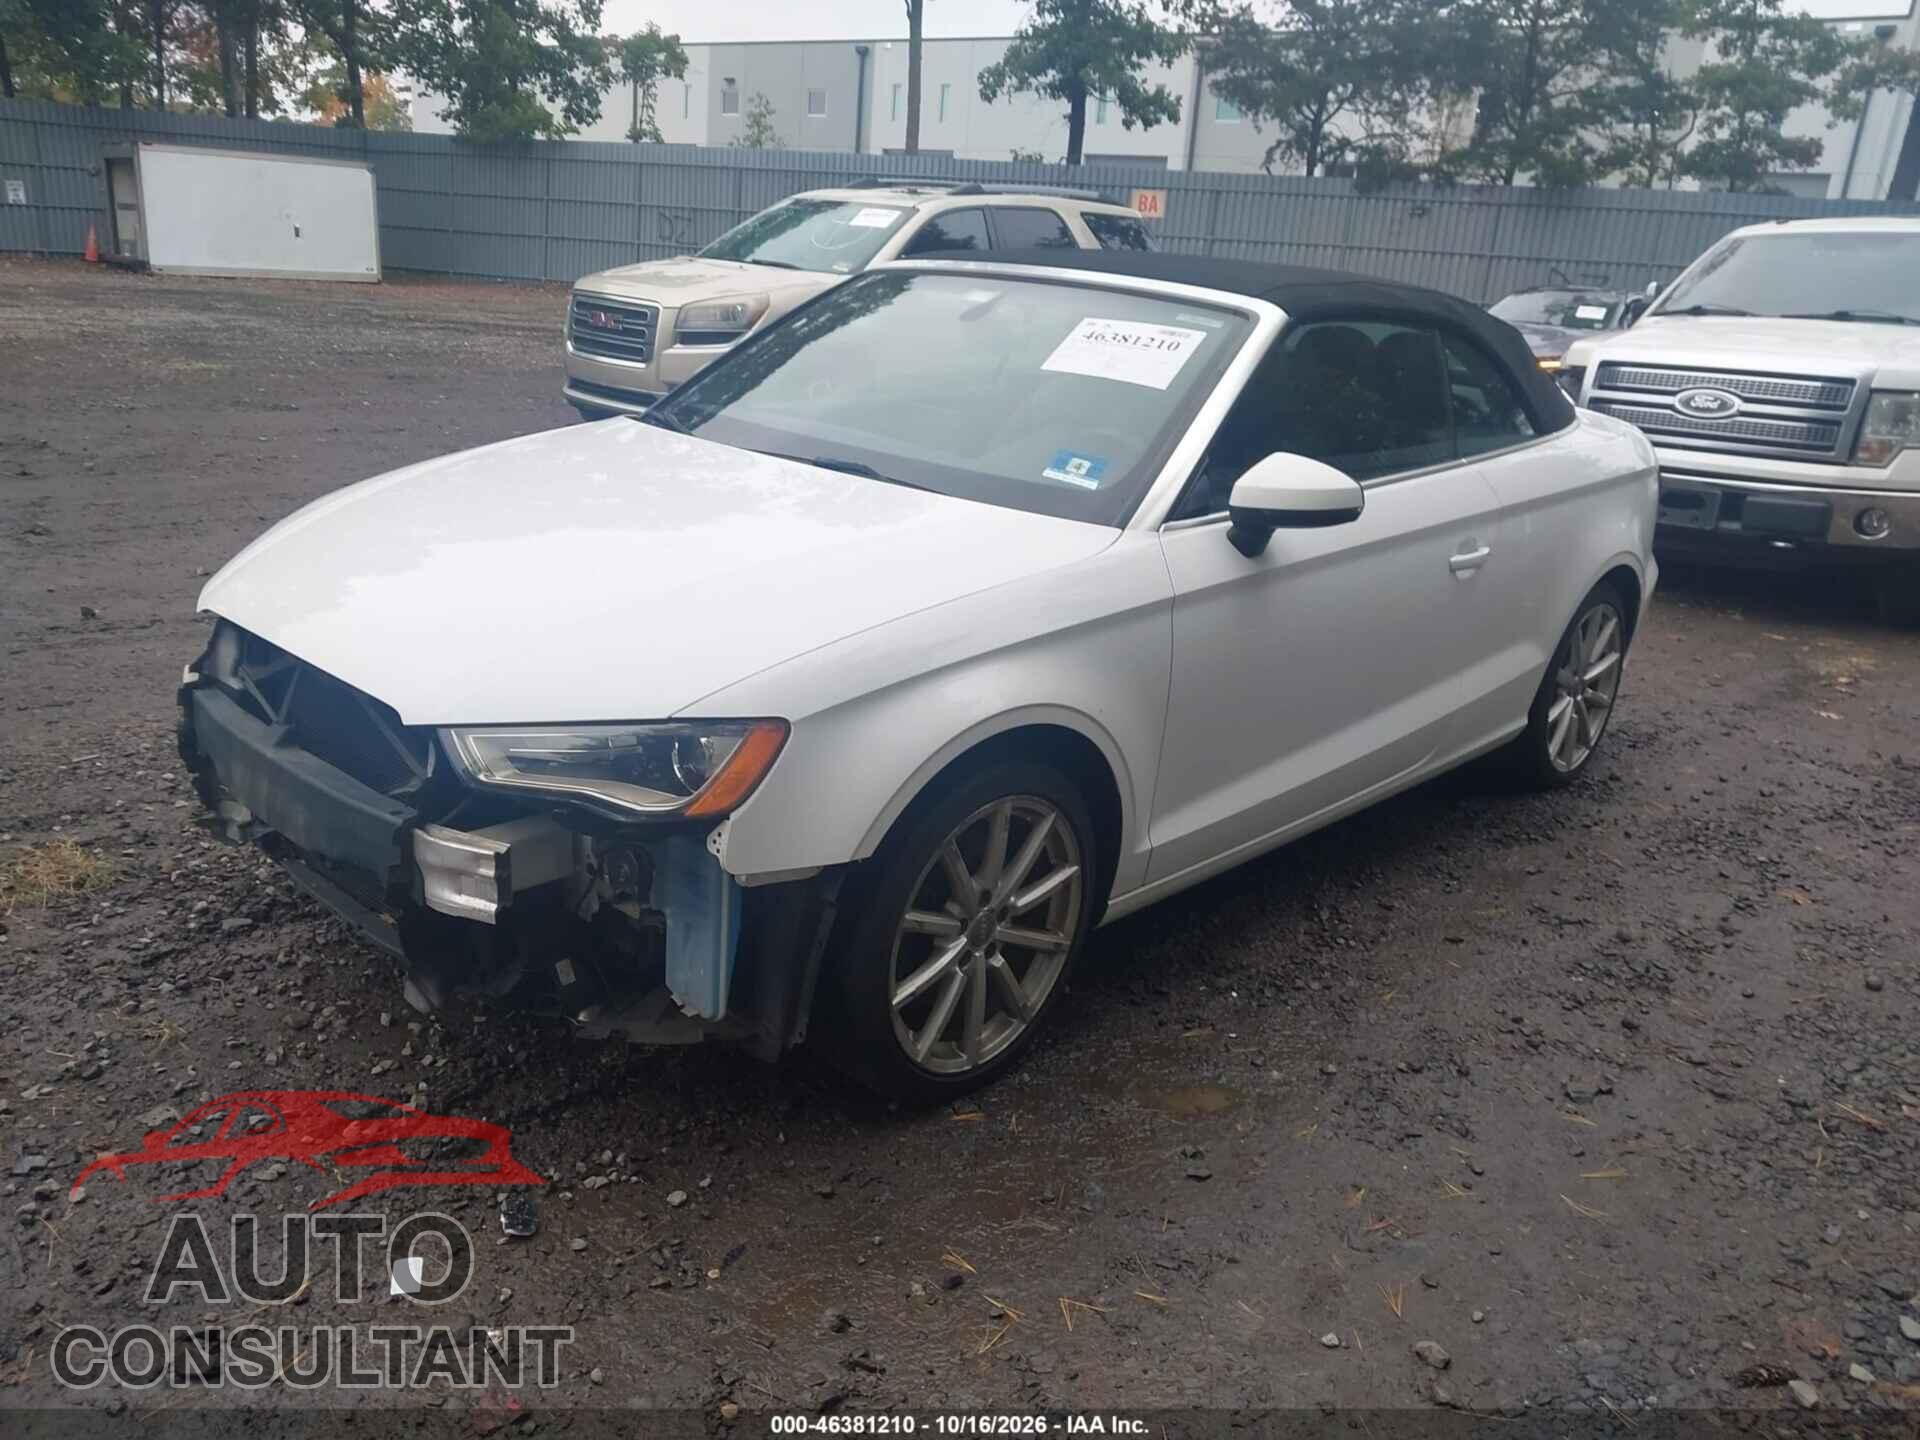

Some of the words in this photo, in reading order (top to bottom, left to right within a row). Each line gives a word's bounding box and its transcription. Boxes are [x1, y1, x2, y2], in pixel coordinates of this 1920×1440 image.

[1138, 193, 1158, 213] BA
[1082, 330, 1181, 351] 46381210
[1690, 394, 1721, 409] Ford
